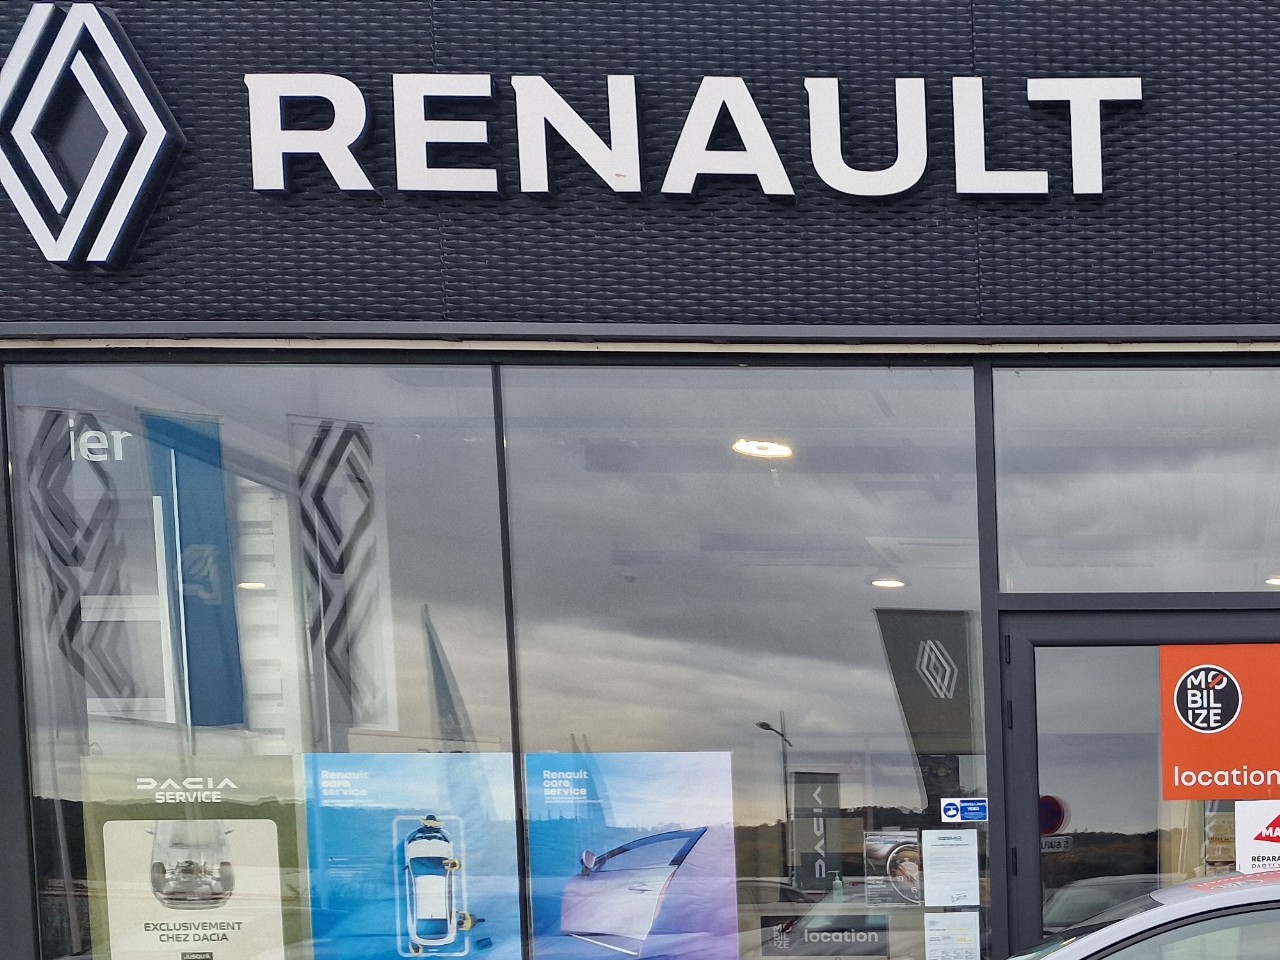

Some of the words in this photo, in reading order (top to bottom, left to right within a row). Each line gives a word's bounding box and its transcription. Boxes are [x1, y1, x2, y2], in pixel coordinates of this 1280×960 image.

[243, 73, 1143, 196] RENAULT
[321, 770, 369, 779] Renault
[543, 769, 589, 779] Renault
[136, 777, 239, 790] DACIA
[543, 779, 570, 788] care
[155, 791, 222, 803] SERVICE
[322, 788, 368, 796] service
[543, 787, 587, 796] service
[144, 921, 243, 932] EXCLUSIVEMENT
[158, 933, 190, 943] CHEZ
[192, 932, 229, 942] DACIA
[804, 929, 879, 943] location
